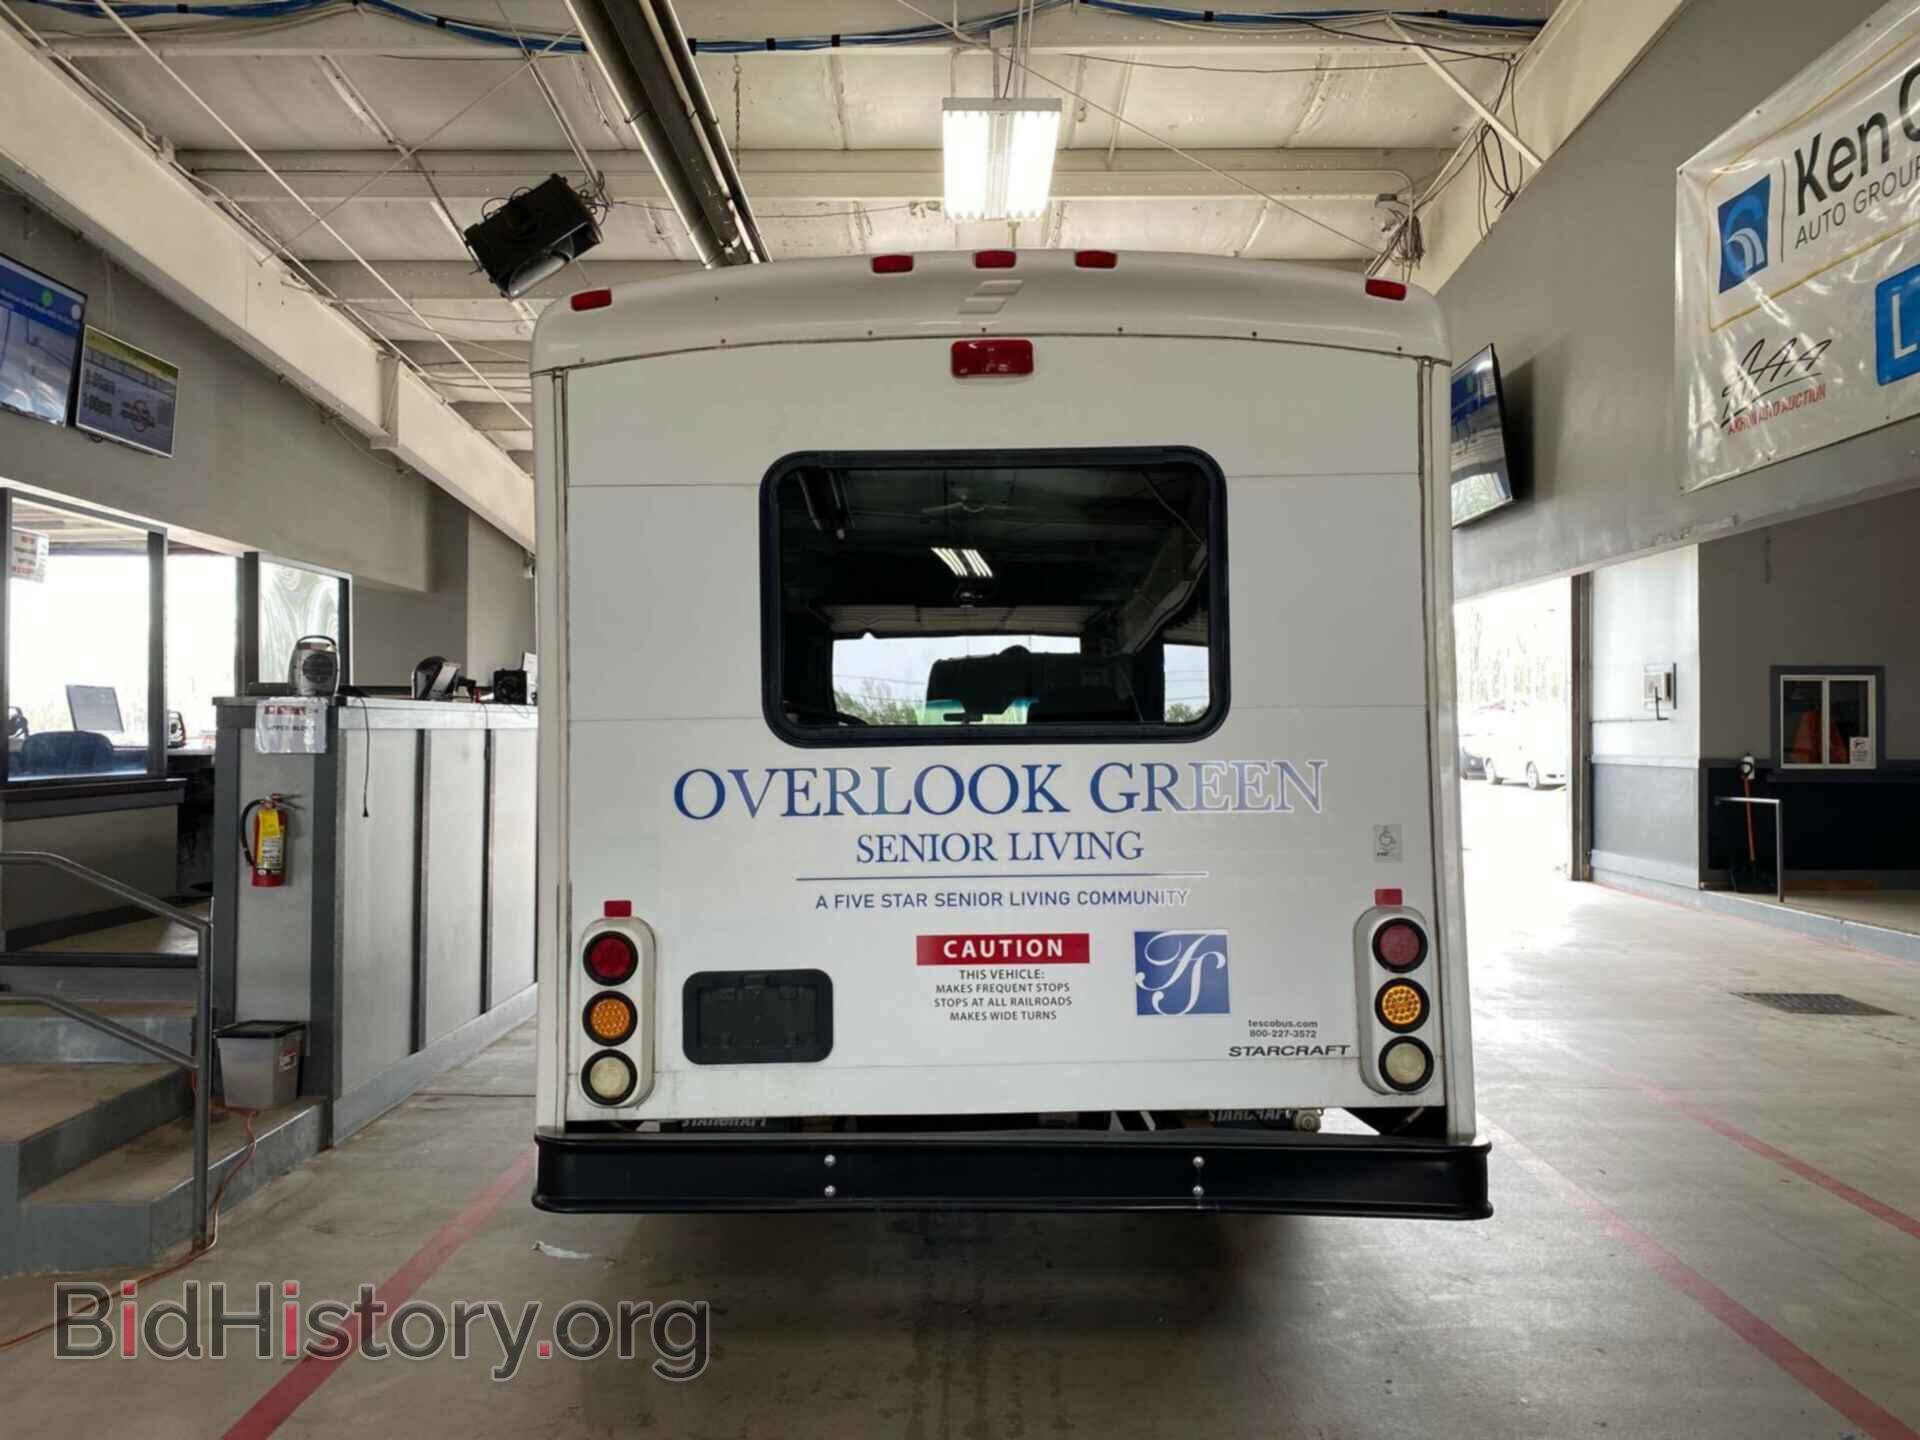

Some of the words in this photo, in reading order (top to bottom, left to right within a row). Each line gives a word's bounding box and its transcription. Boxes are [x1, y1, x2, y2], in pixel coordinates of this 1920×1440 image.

[1794, 112, 1890, 217] Ken
[1795, 201, 1847, 249] AUTO
[674, 763, 1070, 820] OVERLOOK
[1090, 760, 1327, 814] GREEN
[857, 832, 998, 863] SENIOR
[1008, 830, 1144, 861] LIVING
[816, 895, 828, 909] A
[835, 894, 874, 908] FIVE
[881, 893, 927, 908] STAR
[935, 892, 1002, 907] SENIOR
[1010, 891, 1070, 906] LIVING
[1077, 889, 1189, 906] COMMUNITY
[943, 939, 1064, 959] CAUTION
[960, 969, 987, 981] THIS
[990, 969, 1045, 980] VEHICLE:
[936, 984, 973, 994] MAKES
[976, 983, 1033, 994] FREQUENT
[1036, 982, 1070, 993] STOPS
[934, 998, 968, 1008] STOPS
[971, 997, 985, 1007] AT
[987, 997, 1008, 1007] ALL
[1010, 996, 1072, 1007] RAILROADS
[949, 1011, 987, 1021] MAKES
[989, 1011, 1018, 1021] WIDE
[1021, 1010, 1057, 1020] TURNS
[1248, 1019, 1318, 1028] tescobus.com
[1249, 1029, 1317, 1039] 800-227-3572
[1229, 1044, 1350, 1057] STARCRAFT
